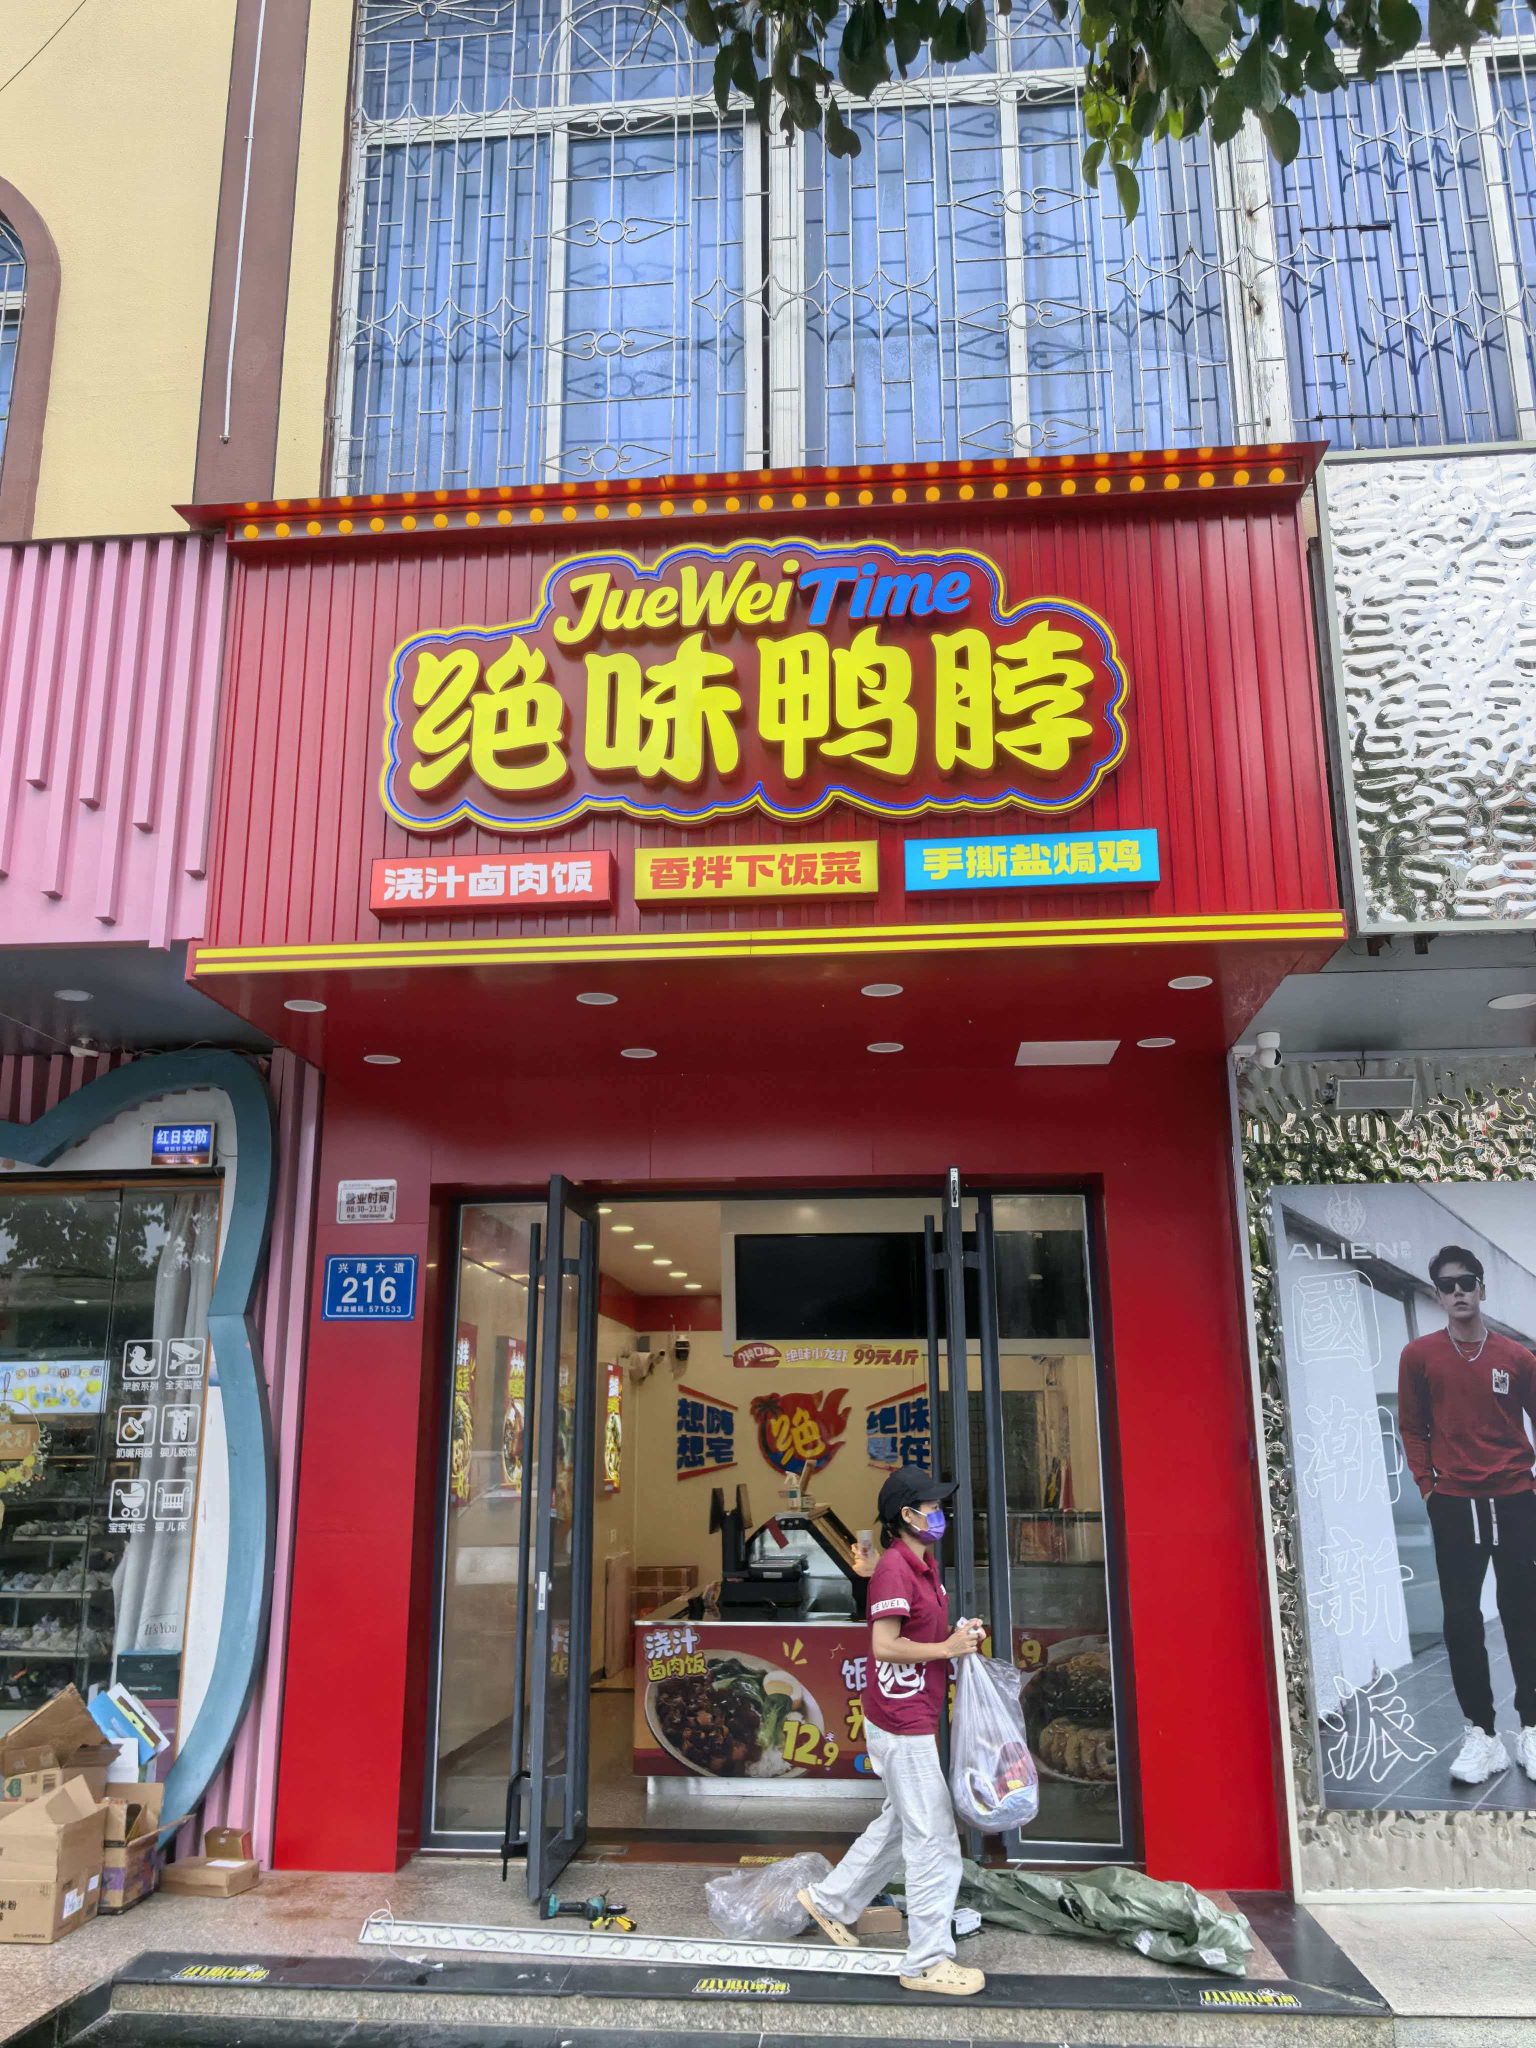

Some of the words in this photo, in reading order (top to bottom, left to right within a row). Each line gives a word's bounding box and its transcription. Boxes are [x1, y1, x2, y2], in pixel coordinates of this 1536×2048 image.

[553, 559, 799, 644] JueWei
[800, 563, 970, 625] Time
[409, 620, 1094, 790] 绝味鸭脖
[922, 839, 1142, 880] 手撕盐焗鸡
[650, 850, 862, 890] 香拌下饭菜
[384, 860, 593, 901] 浇汁卤肉饭
[156, 1128, 208, 1145] 红日安防
[345, 1192, 389, 1204] 营业时间
[1287, 1242, 1398, 1260] ALIEN
[338, 1263, 404, 1274] 兴隆大道
[341, 1276, 397, 1304] 216
[368, 1305, 402, 1313] 571533
[784, 1347, 848, 1363] 绝味小龙虾
[853, 1349, 919, 1366] 99元4斤
[122, 1381, 159, 1392] 早教系列
[165, 1380, 202, 1391] 全天监控
[160, 1447, 197, 1458] 婴儿服饰
[154, 1521, 189, 1532] 婴儿床
[645, 1628, 699, 1659] 浇汁
[648, 1652, 708, 1682] 卤肉饭
[782, 1720, 840, 1767] 12.9
